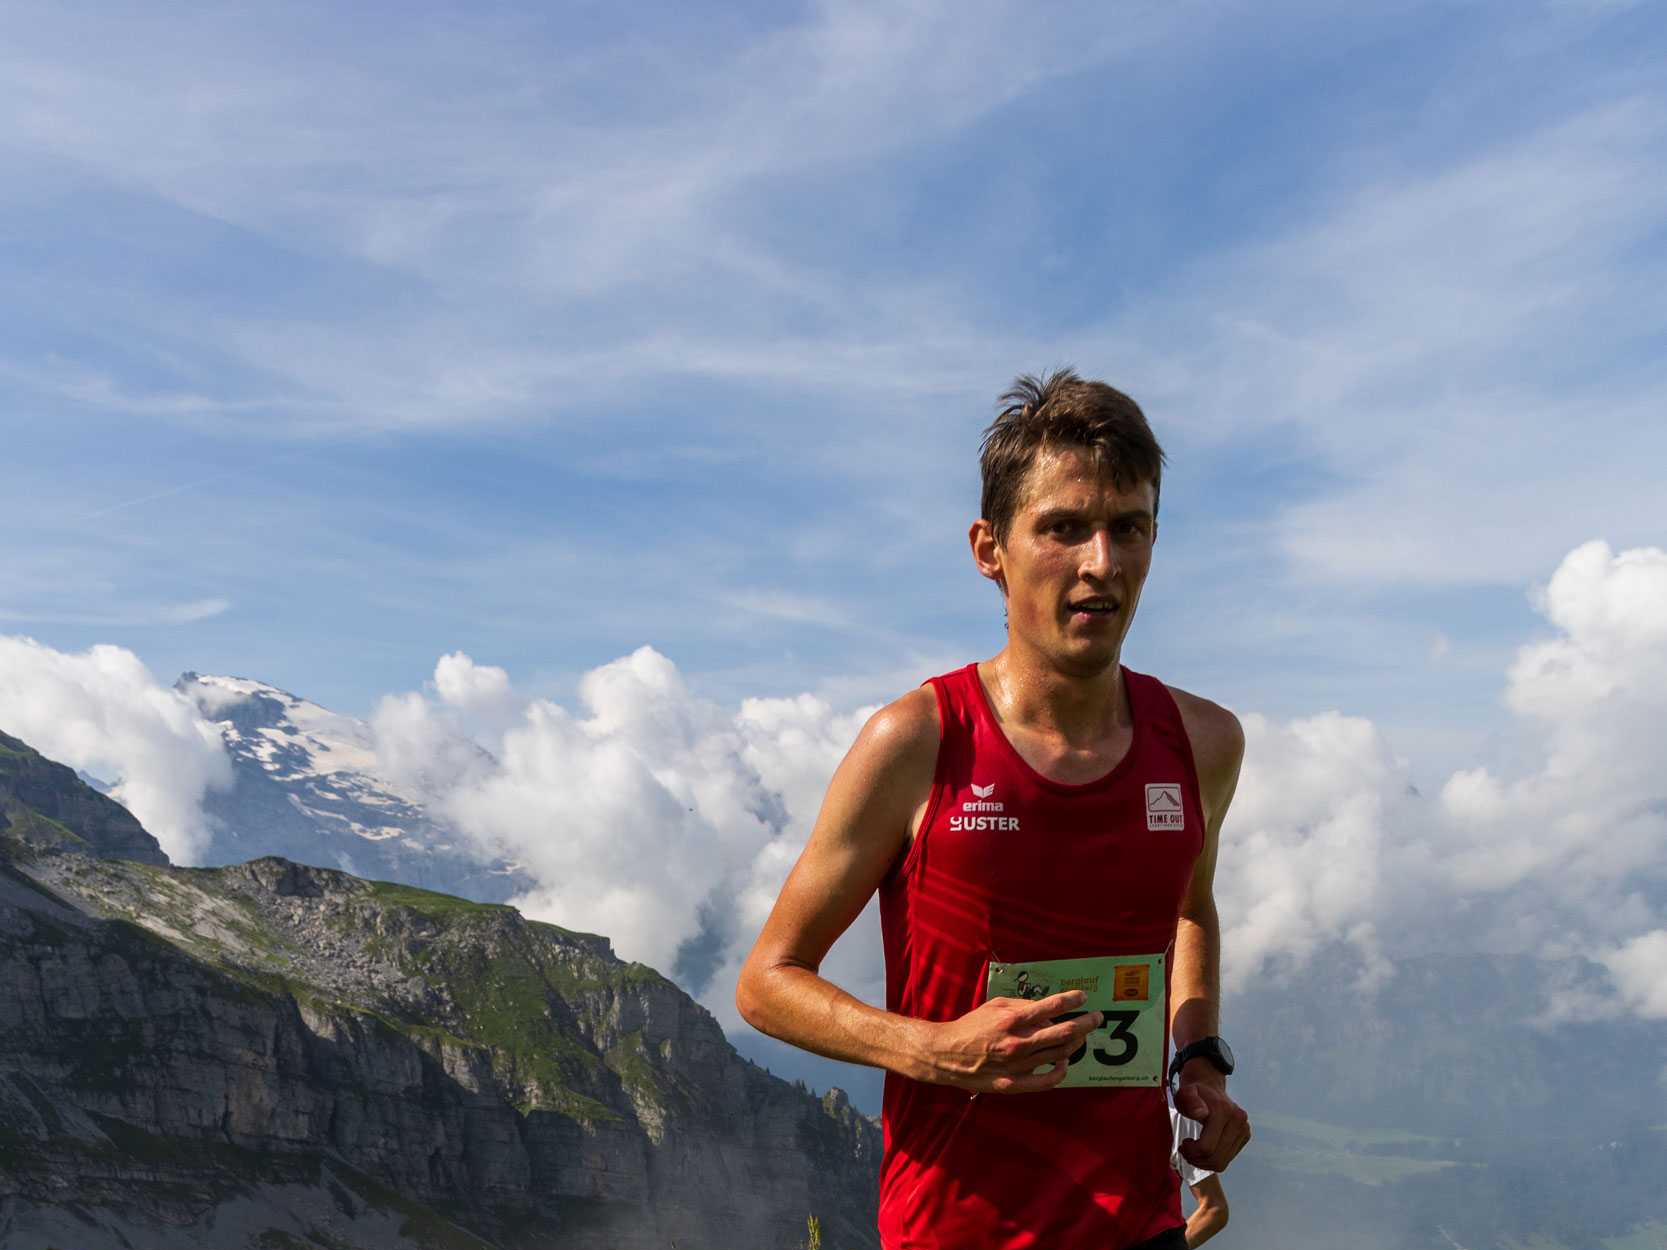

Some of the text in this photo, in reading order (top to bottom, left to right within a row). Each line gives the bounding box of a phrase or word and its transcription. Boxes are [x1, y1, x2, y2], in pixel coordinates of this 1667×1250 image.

[962, 799, 1004, 812] erima
[949, 816, 1021, 831] LC USTER
[1149, 814, 1183, 824] TIME OUT
[1061, 976, 1099, 987] berglauf
